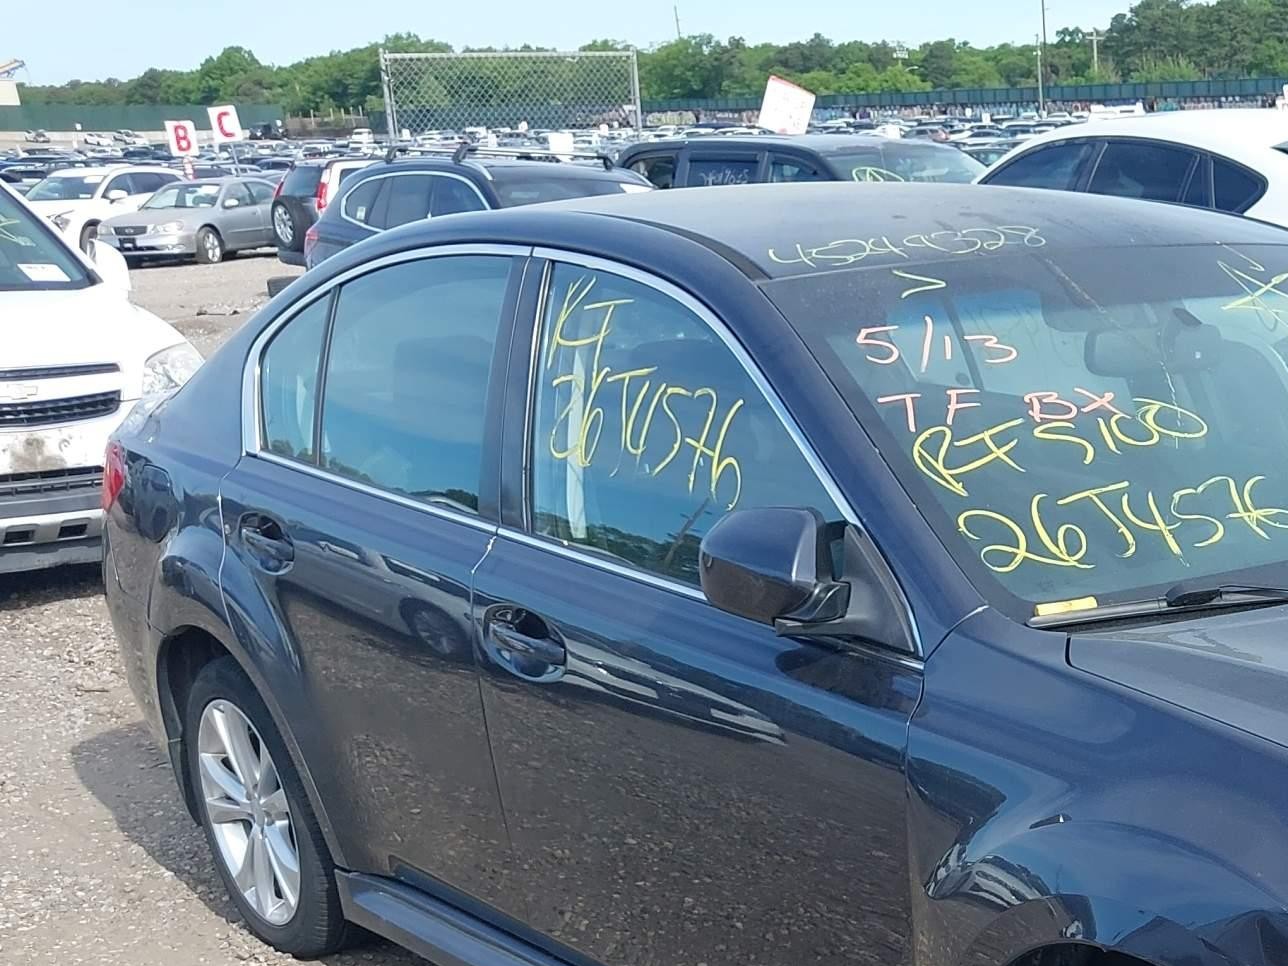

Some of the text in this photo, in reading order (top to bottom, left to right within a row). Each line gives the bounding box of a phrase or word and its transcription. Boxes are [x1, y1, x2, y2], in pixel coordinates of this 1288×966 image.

[174, 125, 191, 152] B
[217, 112, 235, 137] C
[768, 225, 1046, 267] 45249328
[856, 315, 1018, 374] 5/13
